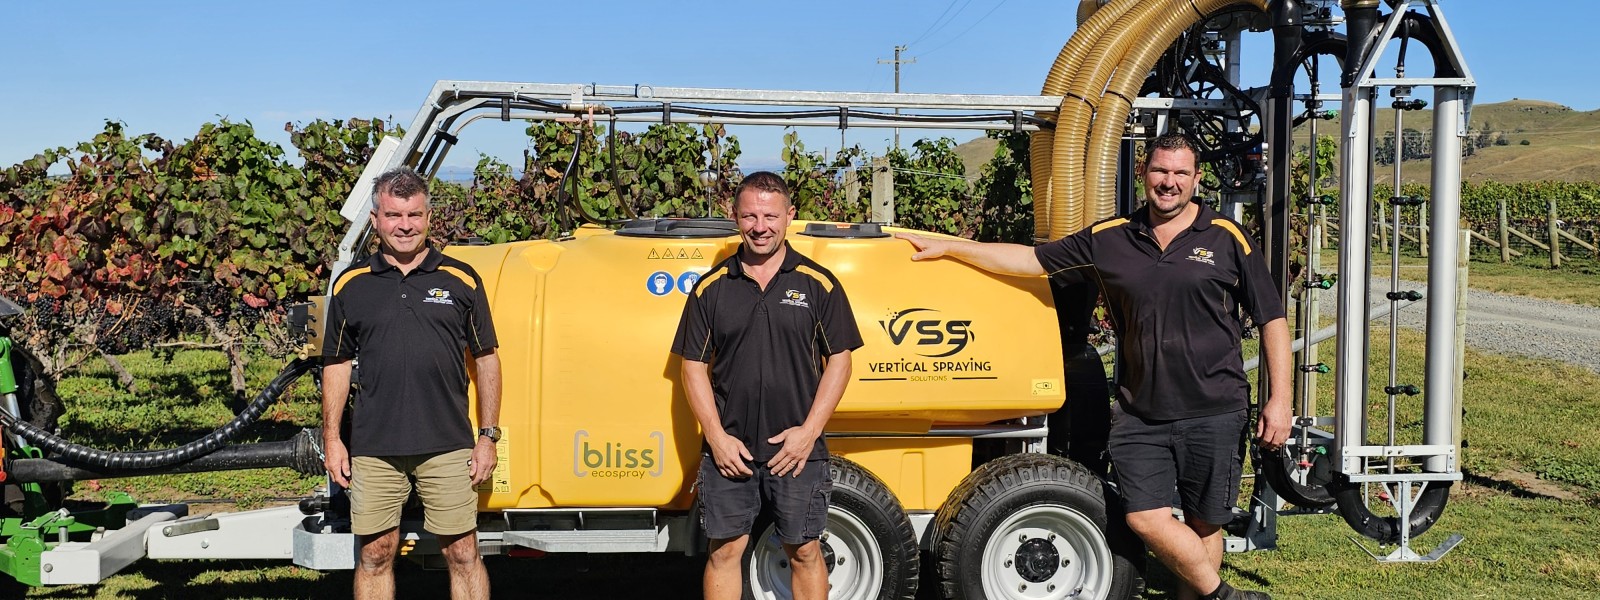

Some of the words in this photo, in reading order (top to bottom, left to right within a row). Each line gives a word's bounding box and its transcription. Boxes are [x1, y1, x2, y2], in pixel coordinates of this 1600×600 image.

[878, 313, 975, 354] VSS
[869, 358, 928, 372] VERTICAL
[933, 357, 992, 372] SPRAYING
[591, 470, 646, 480] ecospray
